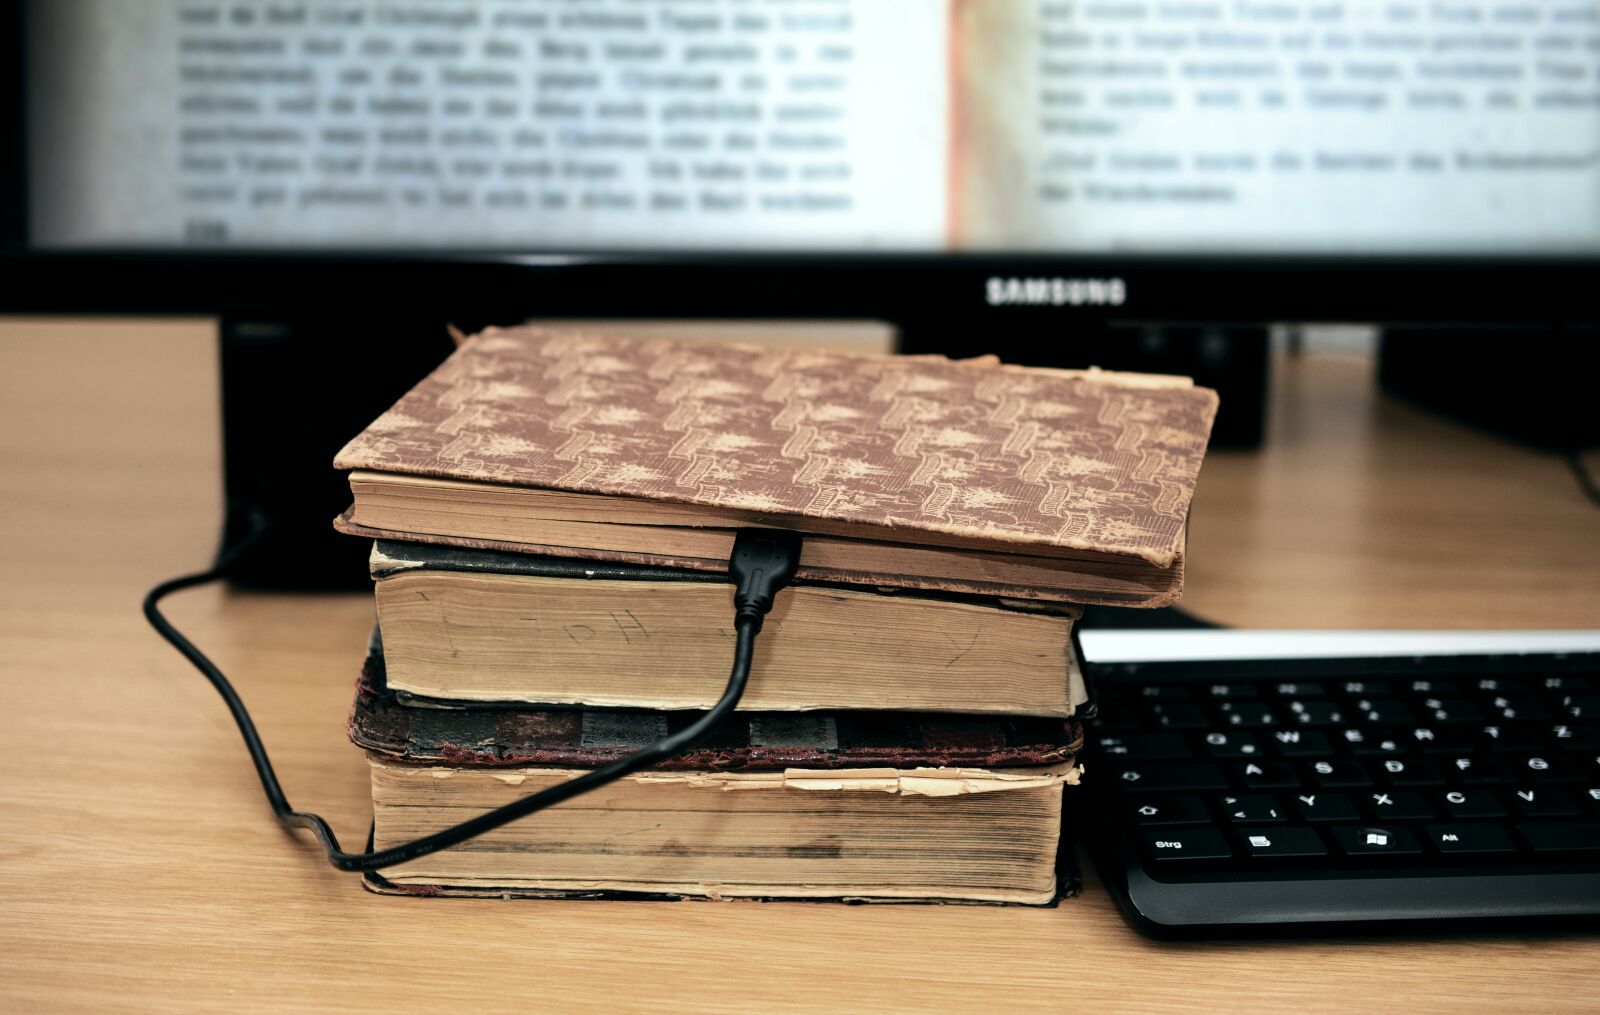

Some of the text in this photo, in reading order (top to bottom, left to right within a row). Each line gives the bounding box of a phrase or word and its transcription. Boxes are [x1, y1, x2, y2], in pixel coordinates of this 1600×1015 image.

[985, 276, 1127, 306] SAMSUNG
[1276, 731, 1300, 744] W
[1246, 763, 1263, 775] A
[1315, 761, 1334, 774] S
[1384, 760, 1404, 773] D
[1455, 758, 1471, 770] F
[1528, 757, 1549, 770] G
[1299, 794, 1315, 807] Y
[1372, 793, 1393, 805] X
[1446, 791, 1466, 804] C
[1517, 790, 1534, 802] V
[1442, 833, 1459, 842] Alt
[1155, 840, 1182, 849] Strg
